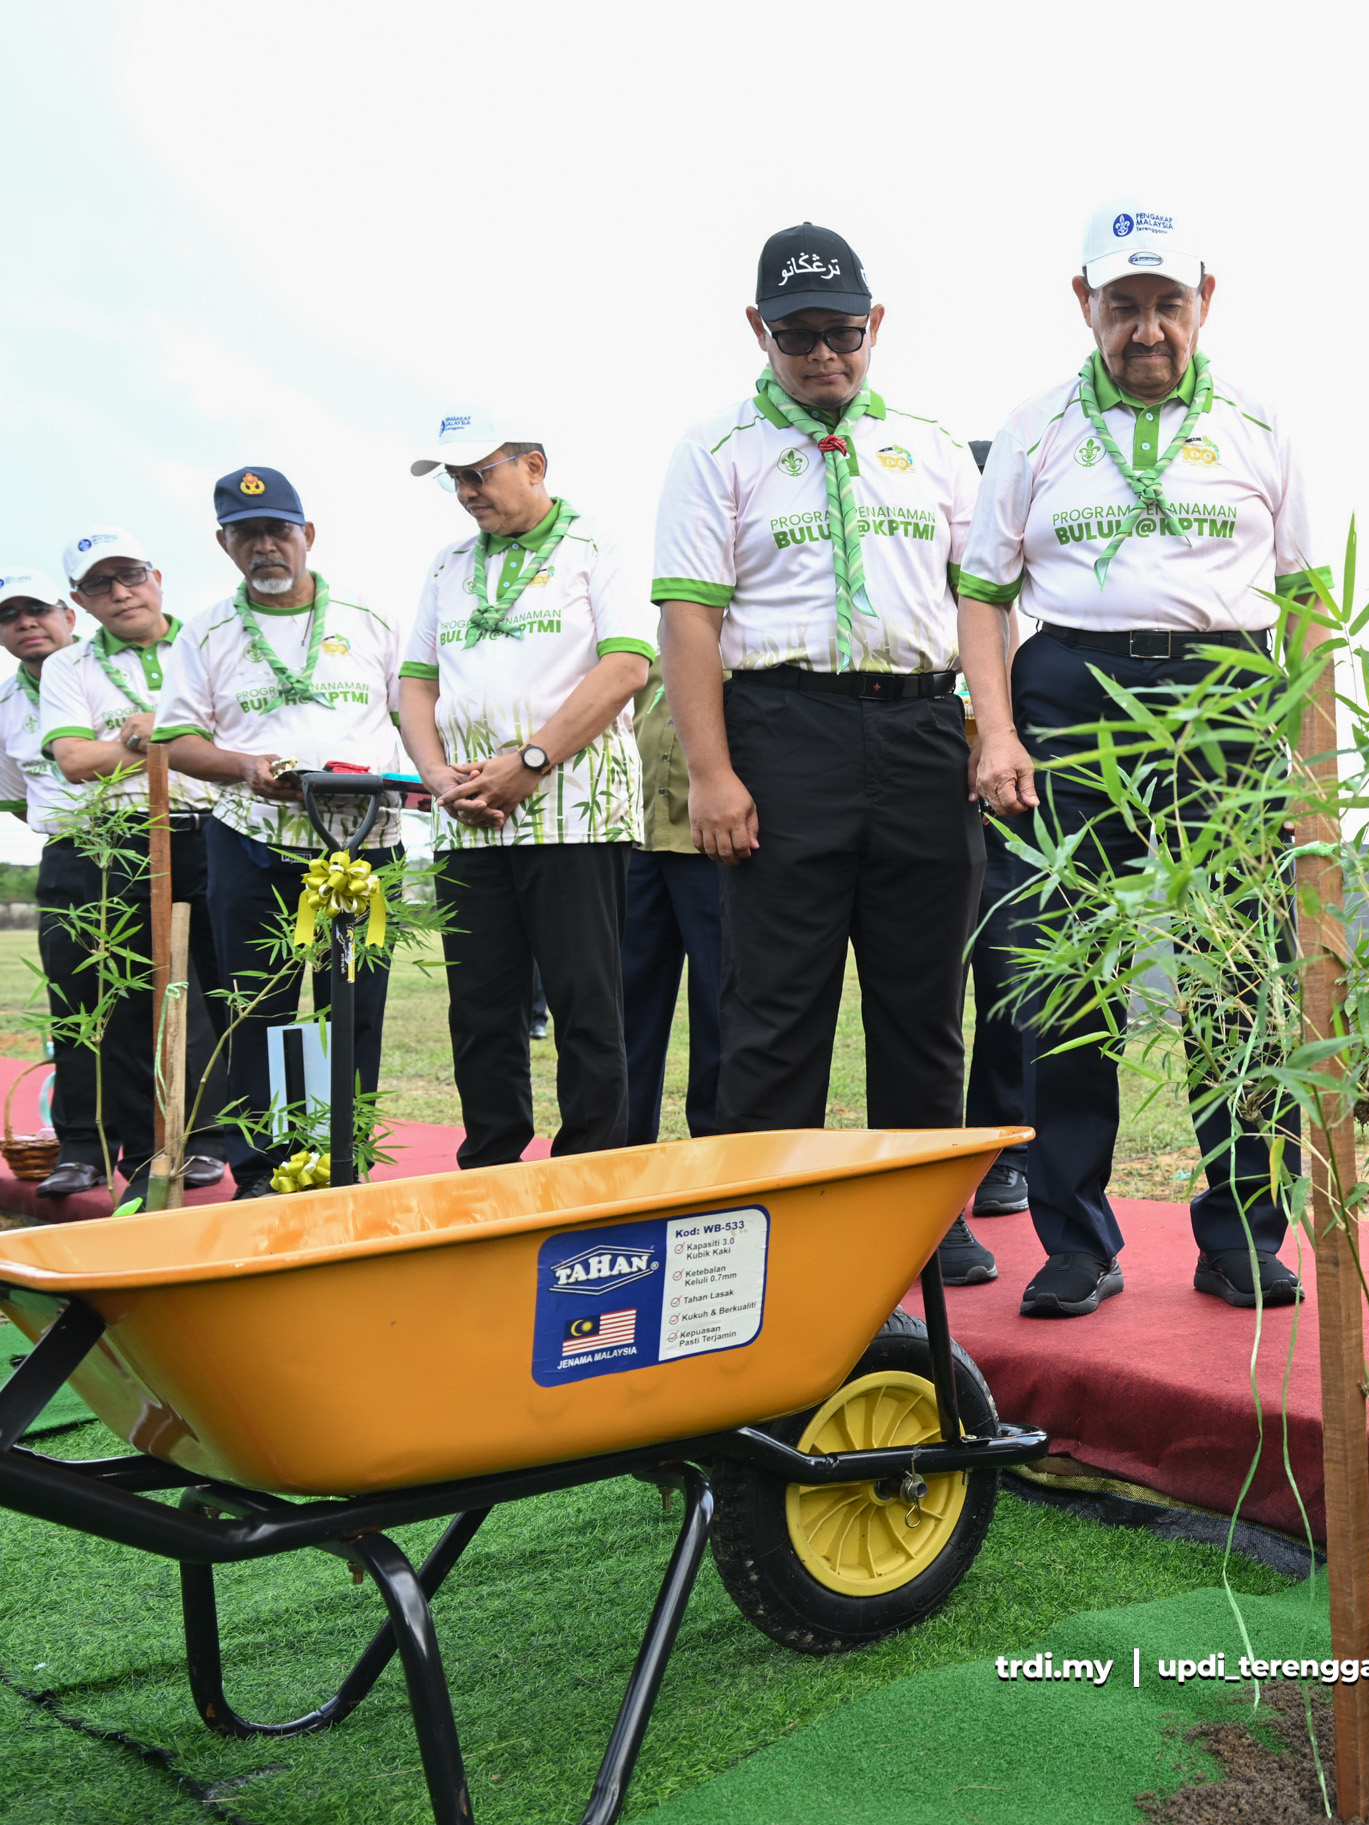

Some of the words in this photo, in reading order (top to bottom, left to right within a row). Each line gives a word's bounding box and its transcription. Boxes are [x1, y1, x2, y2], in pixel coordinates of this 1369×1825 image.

[1136, 213, 1173, 223] PENGAKAP
[1136, 219, 1174, 230] MALAYSIA
[770, 509, 830, 531] PROGRA
[855, 506, 936, 523] ENANAMAN
[1052, 504, 1131, 526] PROGRAM
[675, 1228, 700, 1238] Kod:
[703, 1220, 745, 1234] WB-533
[687, 1240, 720, 1251] Kapasiti
[722, 1237, 735, 1246] 3.0
[686, 1250, 710, 1260] Kubik
[712, 1247, 731, 1256] Kaki
[555, 1254, 649, 1285] TAHAN
[685, 1265, 726, 1278] Ketebalan
[684, 1276, 708, 1287] Keluli
[710, 1272, 737, 1282] 0.7mm
[683, 1294, 708, 1304] Tahan
[710, 1289, 734, 1299] Lasak
[681, 1310, 708, 1321] Kukuh
[710, 1308, 717, 1316] &
[719, 1301, 757, 1315] Berkualiti
[679, 1325, 721, 1338] Kepuasan
[679, 1336, 700, 1347] Pasti
[702, 1330, 737, 1342] Terjamin
[557, 1354, 593, 1369] JENAMA
[594, 1346, 637, 1361] MALAYSIA
